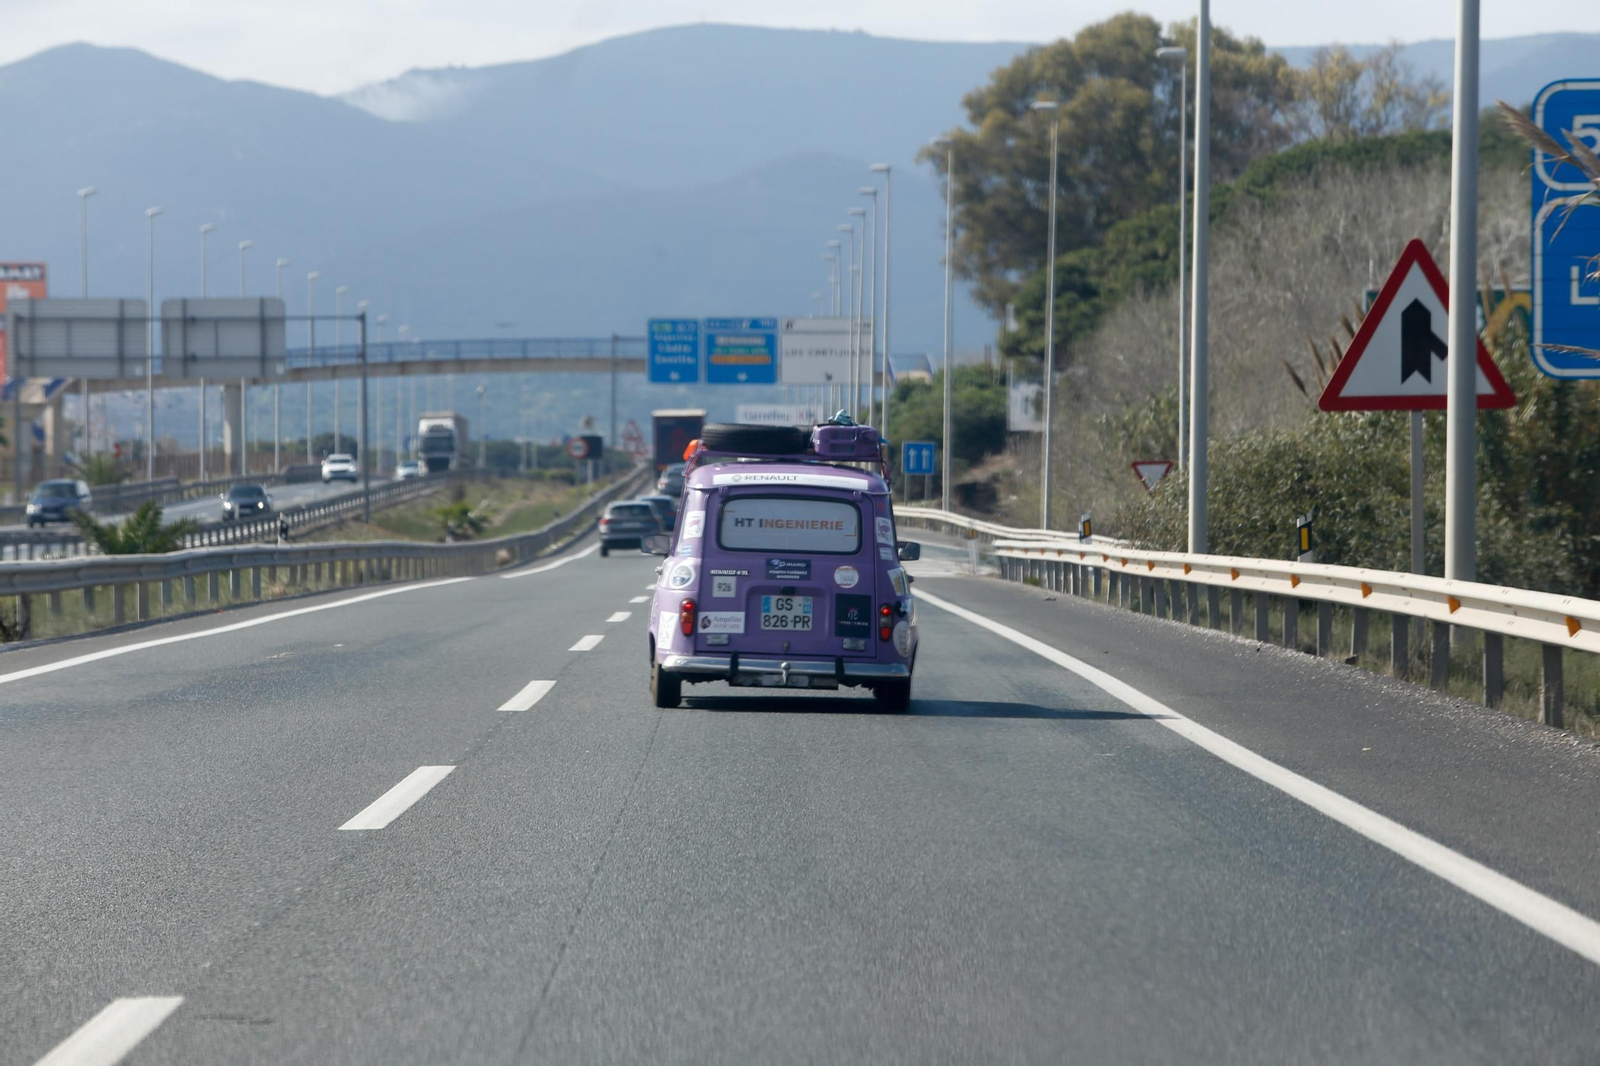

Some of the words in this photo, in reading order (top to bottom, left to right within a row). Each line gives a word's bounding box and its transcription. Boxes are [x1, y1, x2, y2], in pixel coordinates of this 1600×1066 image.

[734, 518, 754, 527] HT
[759, 518, 844, 530] INGENIERIE
[717, 582, 732, 592] 926
